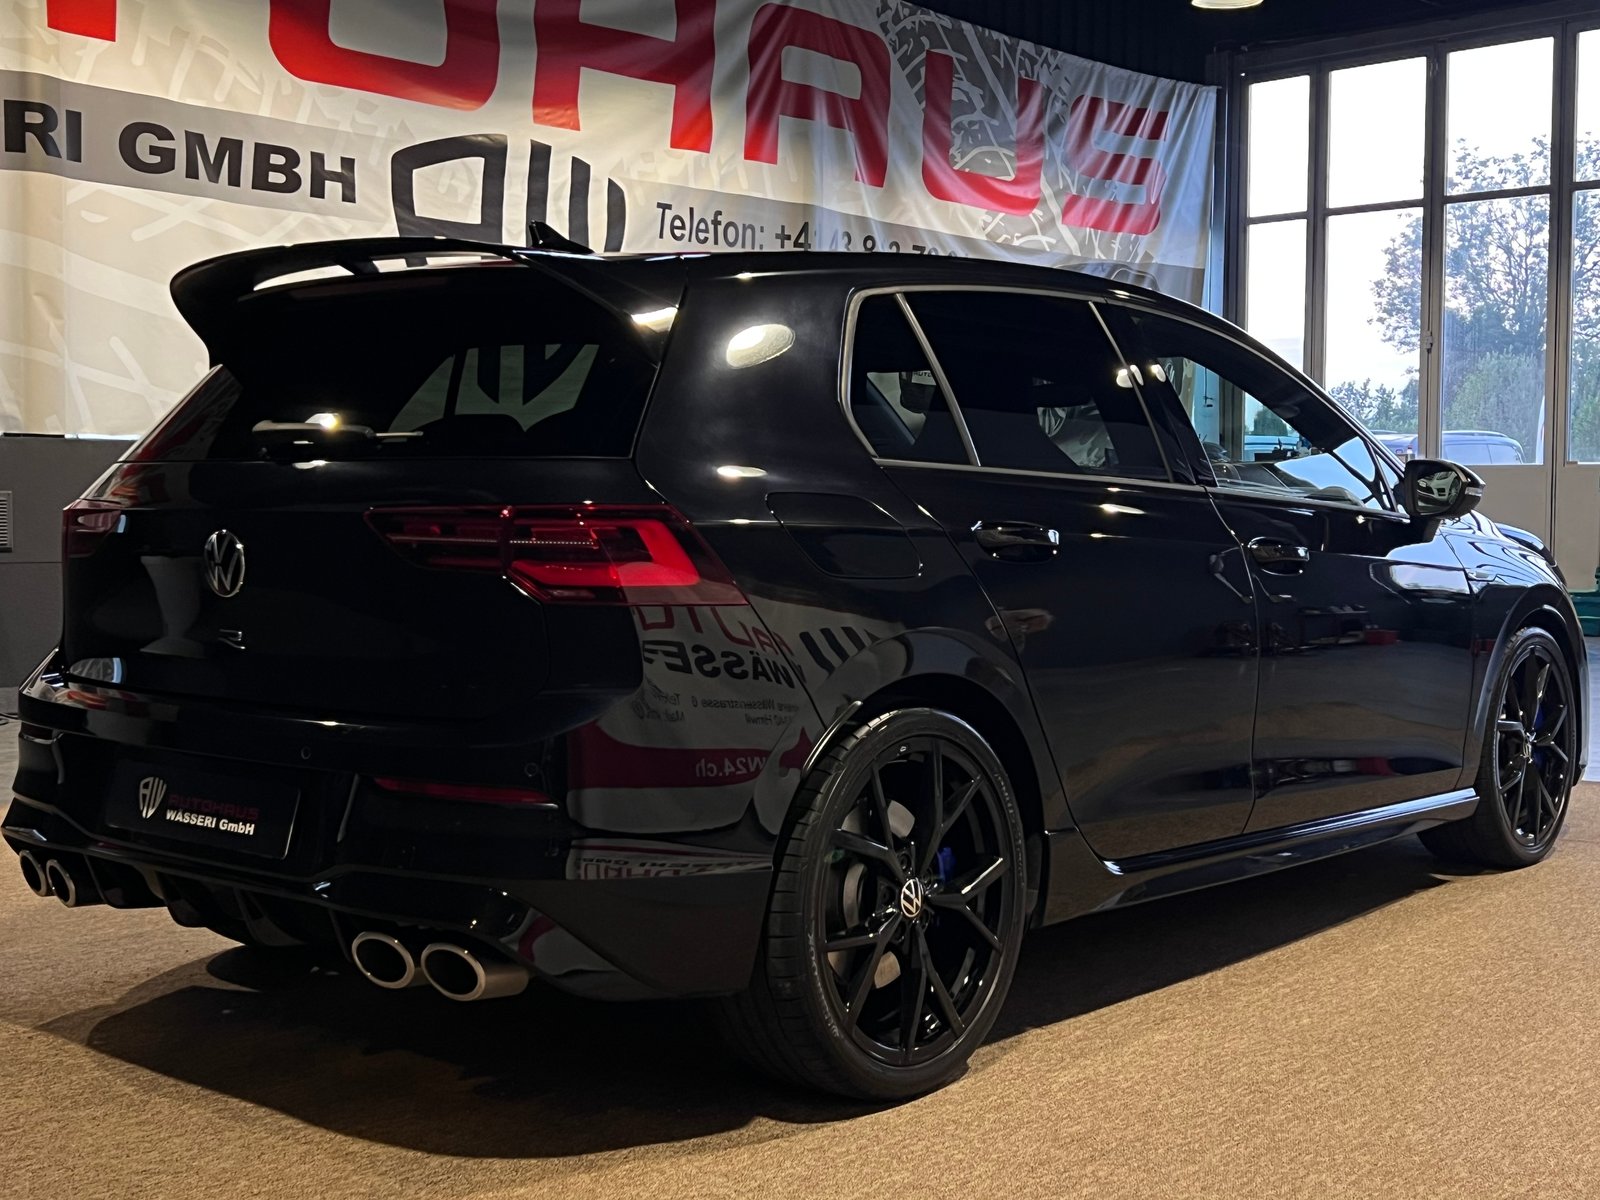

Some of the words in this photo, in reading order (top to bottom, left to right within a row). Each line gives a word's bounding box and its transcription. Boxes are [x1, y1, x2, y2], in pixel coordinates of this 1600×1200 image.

[118, 121, 356, 204] GMBH
[656, 201, 765, 250] Telefon:
[165, 808, 218, 829] WÄSSERI
[218, 818, 256, 836] GmbH
